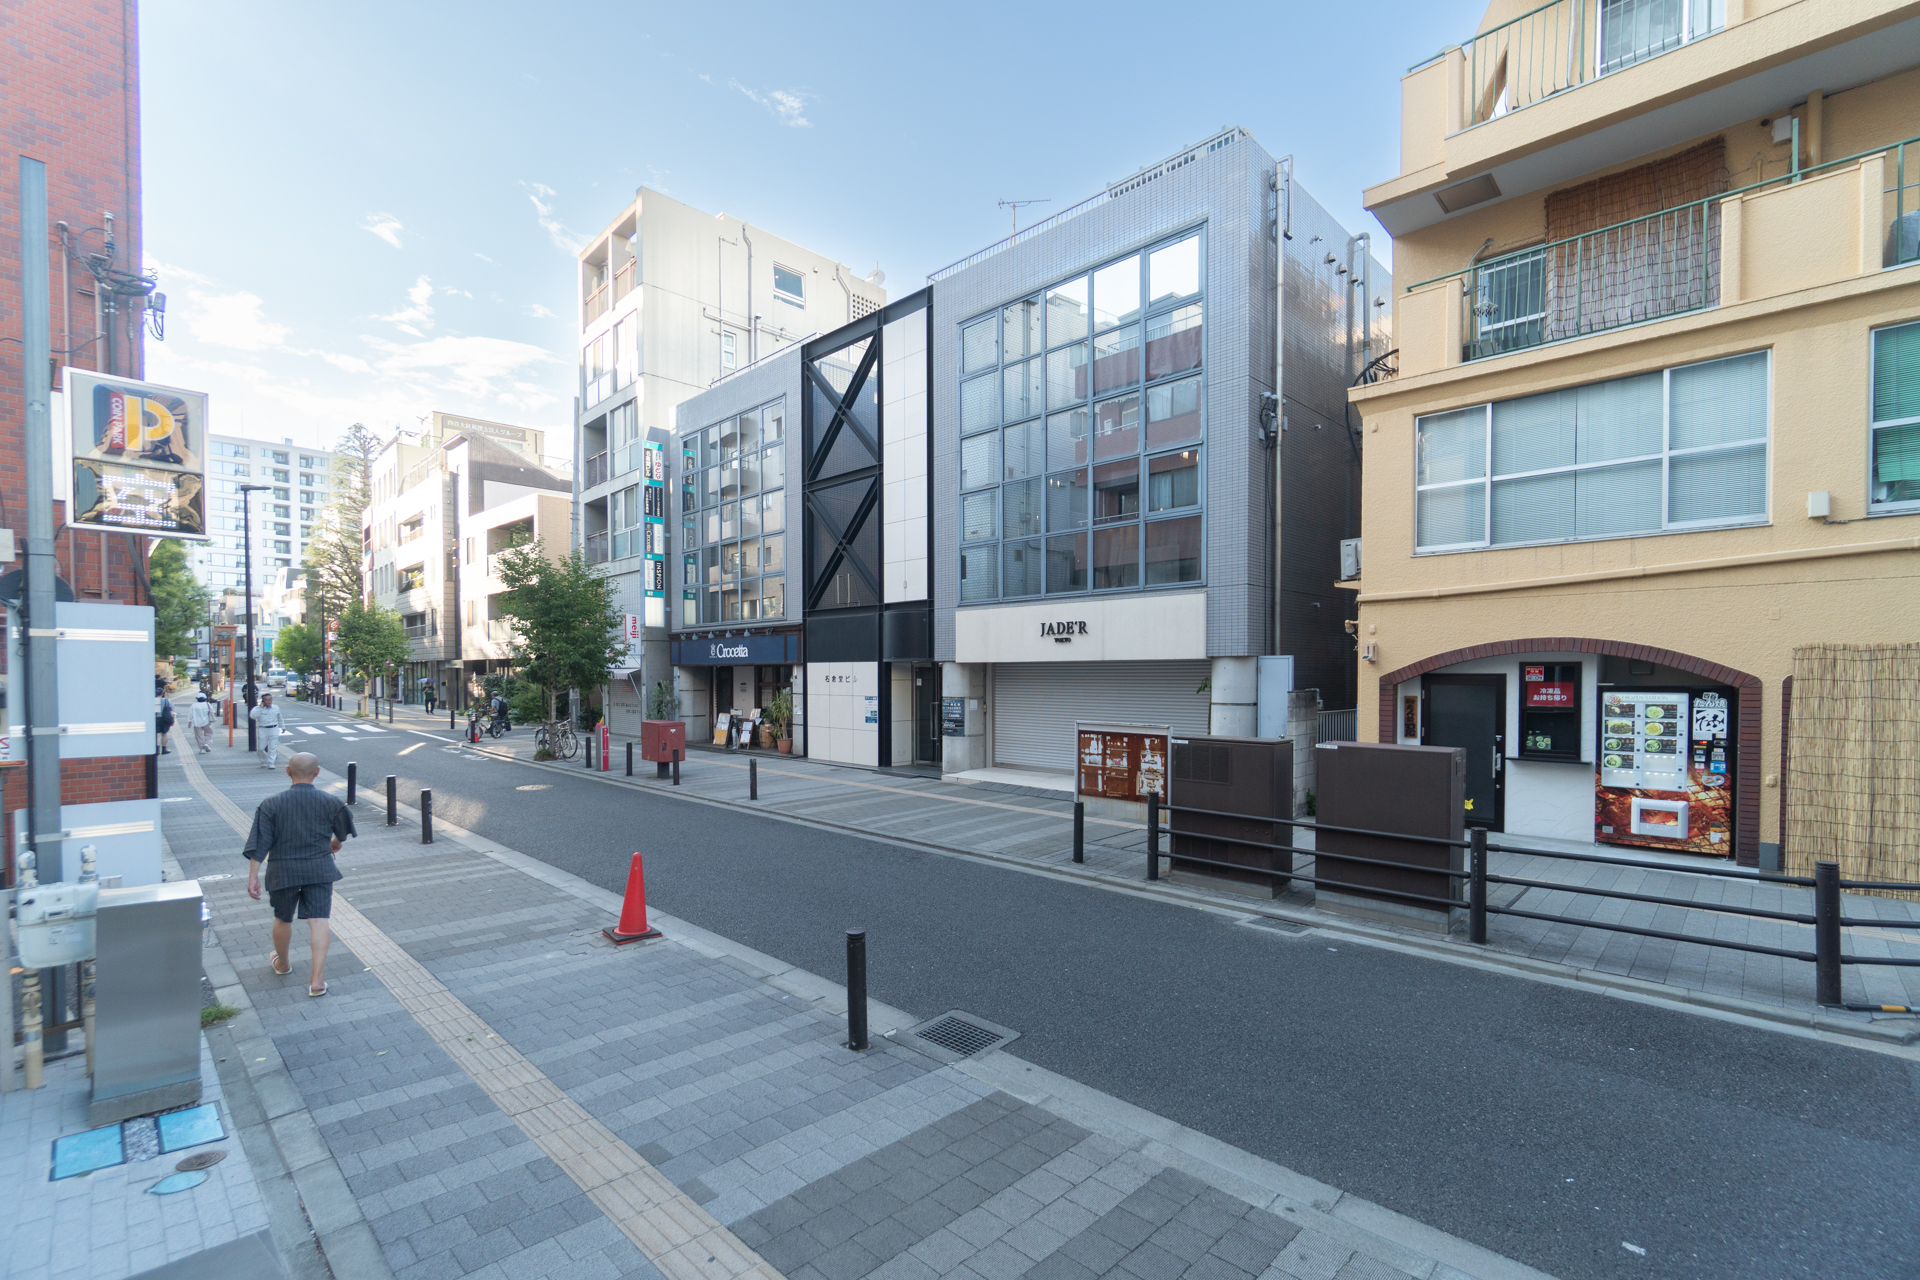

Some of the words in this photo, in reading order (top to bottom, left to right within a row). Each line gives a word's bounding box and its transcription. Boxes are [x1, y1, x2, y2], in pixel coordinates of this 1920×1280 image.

[111, 397, 123, 420] COIN
[112, 420, 123, 446] PARK
[101, 473, 177, 528] 空
[630, 616, 639, 639] meiji
[1040, 620, 1088, 637] JADE'R
[716, 643, 748, 658] Crocetta
[1532, 694, 1567, 702] お持ち帰り
